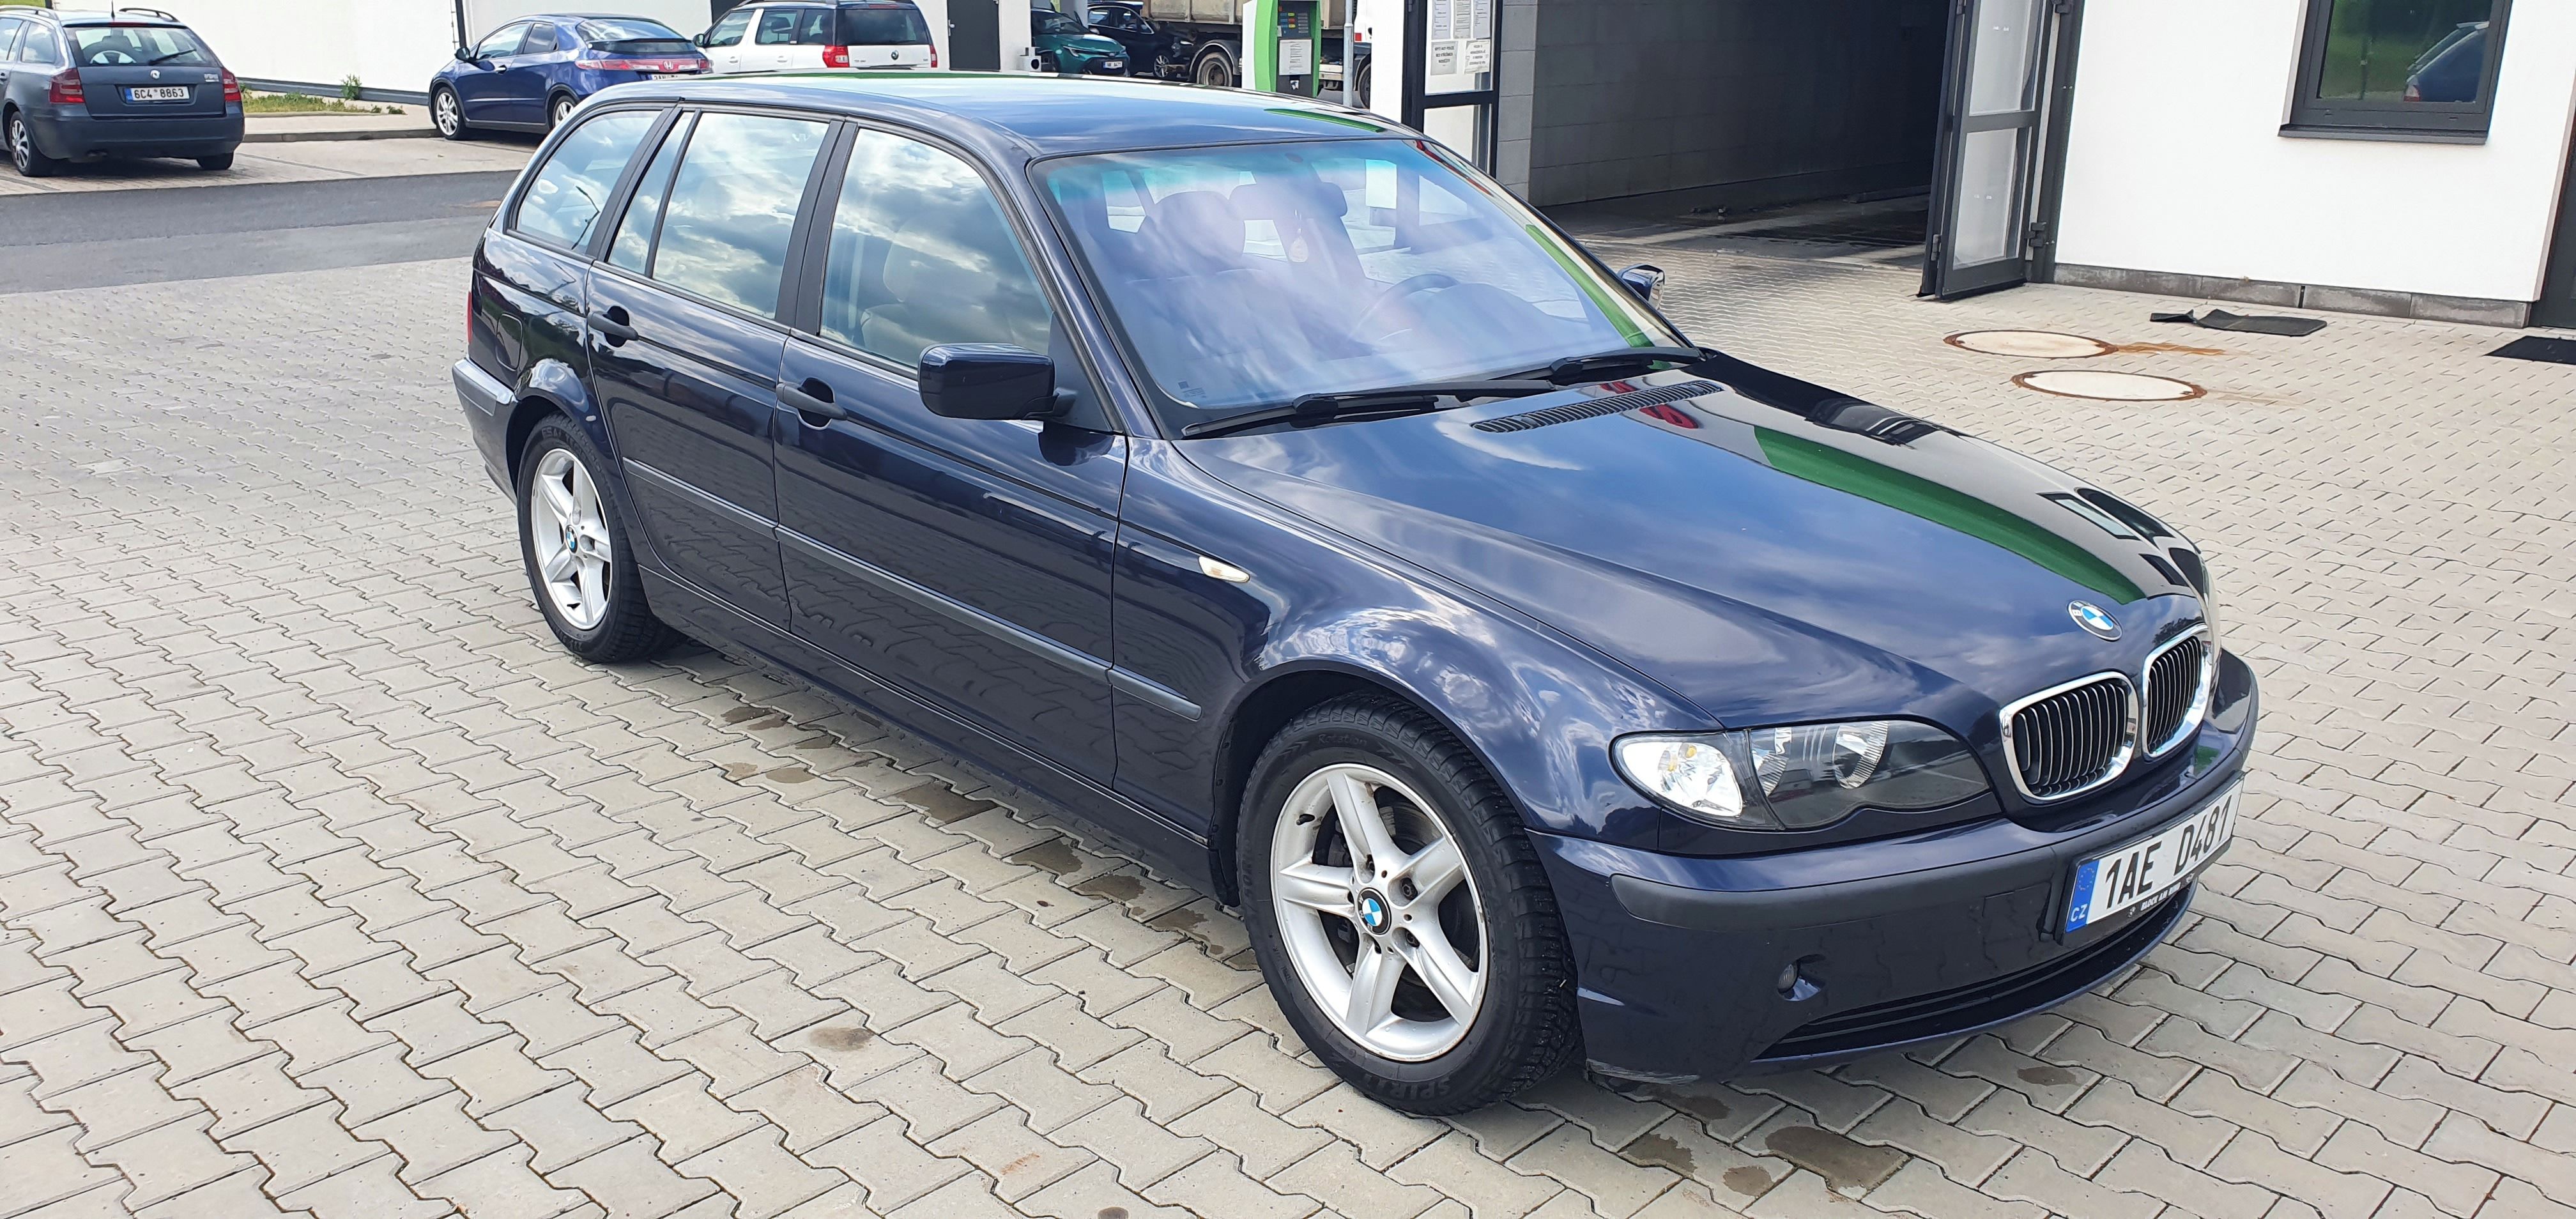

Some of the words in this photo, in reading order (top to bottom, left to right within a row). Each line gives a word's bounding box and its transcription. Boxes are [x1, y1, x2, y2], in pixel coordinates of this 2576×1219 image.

[134, 89, 153, 98] 6C4
[160, 88, 184, 98] 8863
[1317, 733, 1367, 746] Rotation
[2105, 839, 2163, 909] 1AE
[2174, 794, 2232, 877] D481
[2070, 903, 2089, 923] CZ
